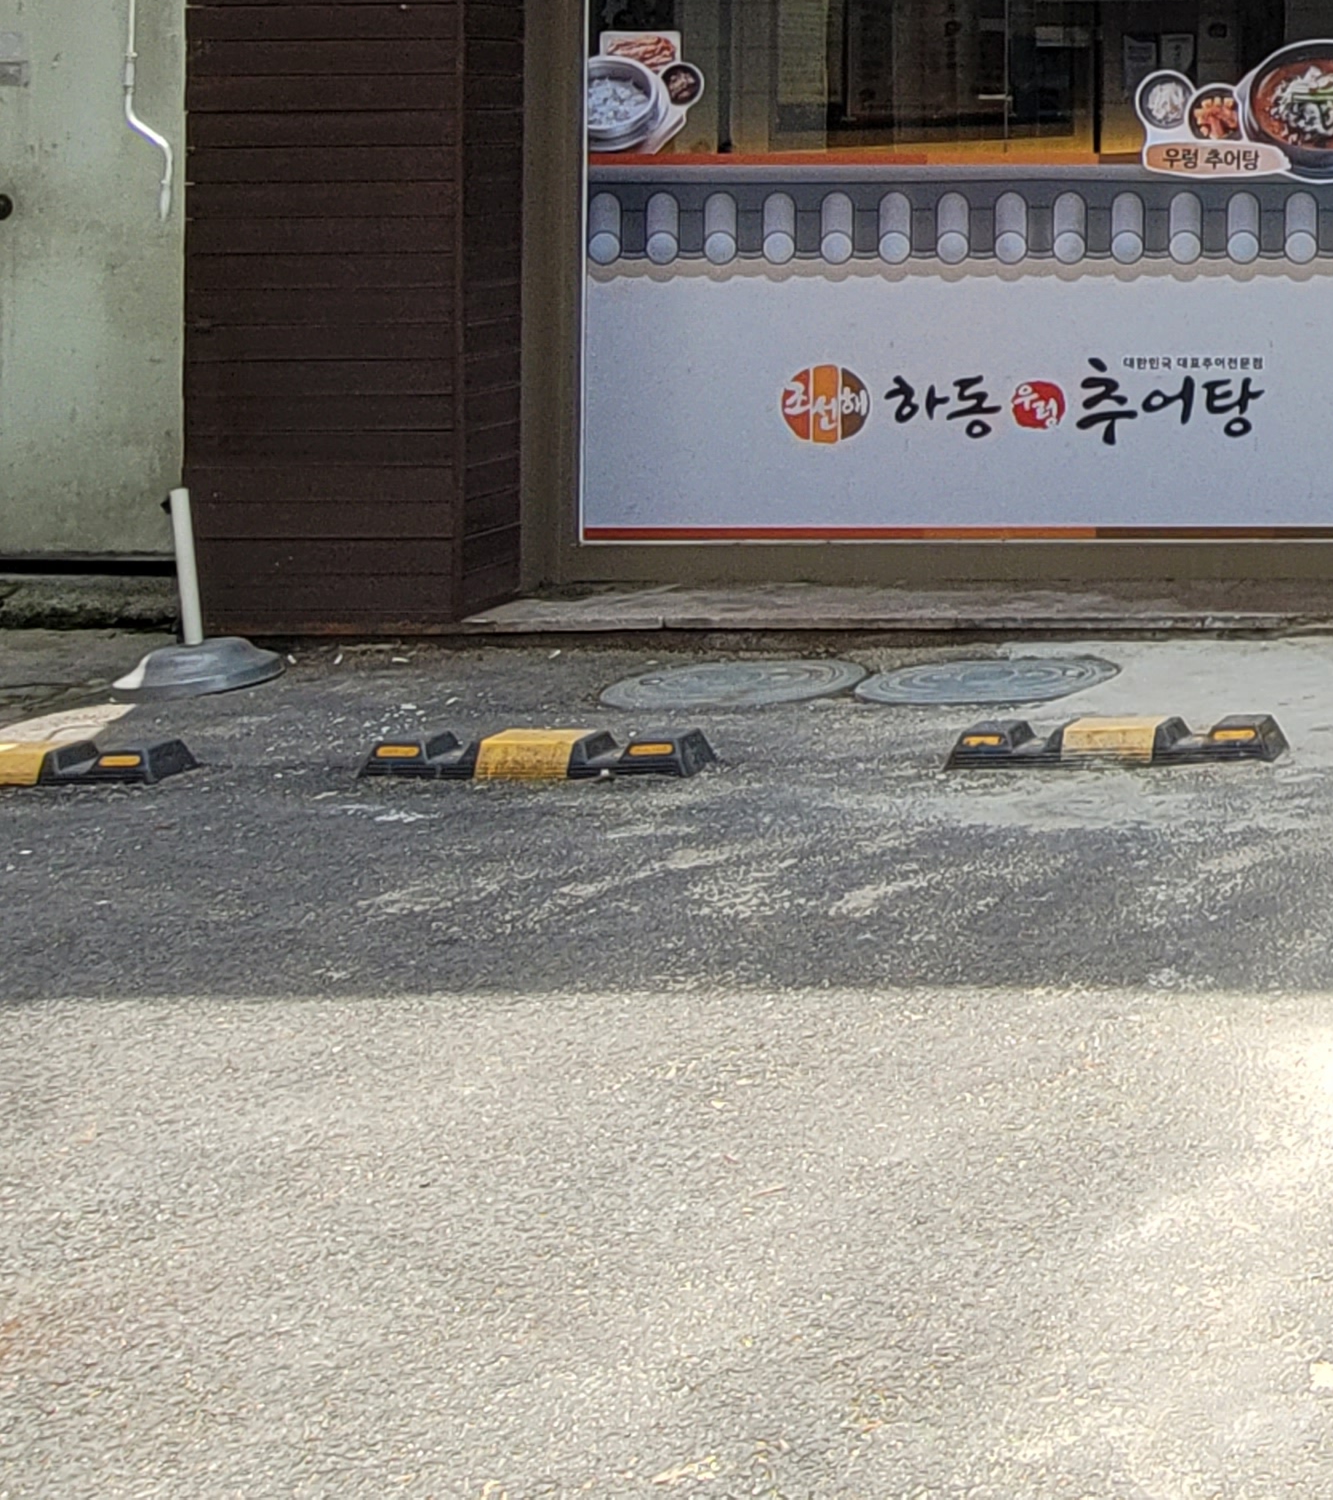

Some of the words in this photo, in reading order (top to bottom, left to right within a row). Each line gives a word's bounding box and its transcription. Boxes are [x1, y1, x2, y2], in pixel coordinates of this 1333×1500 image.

[1162, 148, 1199, 169] 우렁
[1204, 148, 1259, 170] 추어탕
[1123, 356, 1172, 370] 대한민국
[784, 379, 869, 431] 조선해
[884, 375, 1002, 439] 하동
[1013, 386, 1061, 427] 우렁
[1075, 357, 1265, 446] 추어탕
